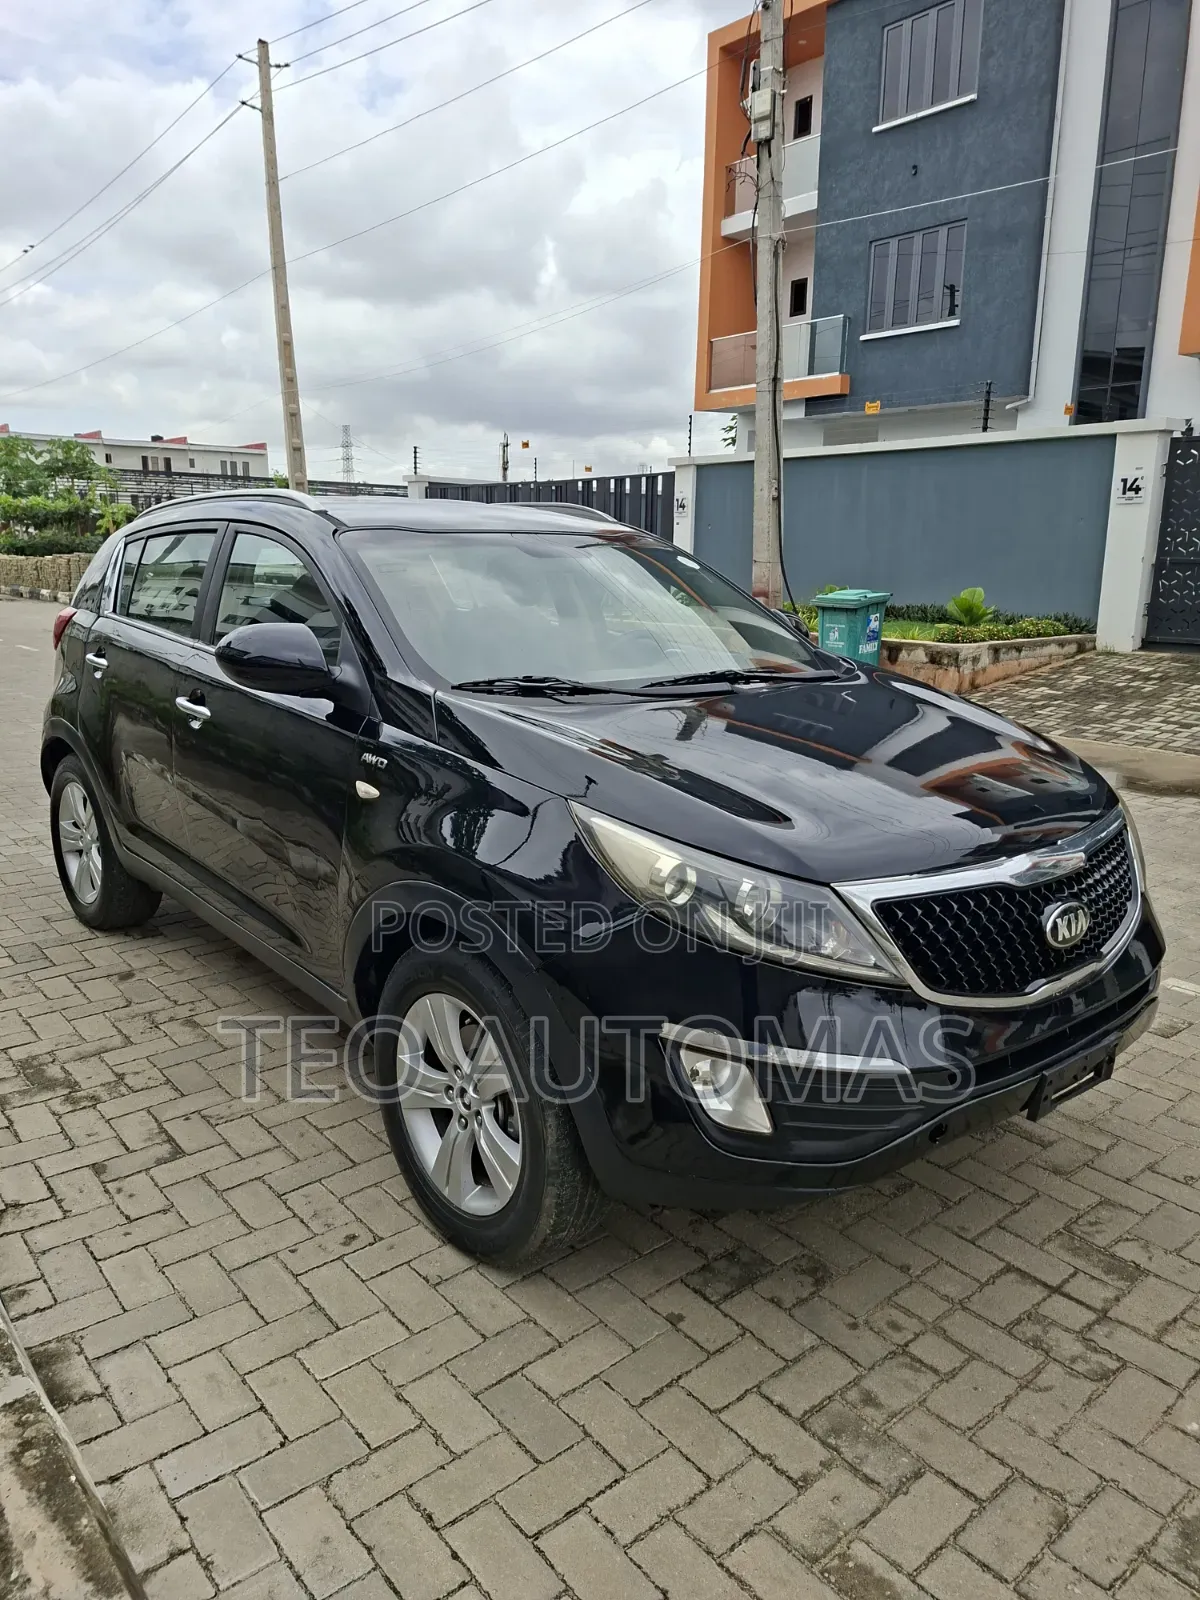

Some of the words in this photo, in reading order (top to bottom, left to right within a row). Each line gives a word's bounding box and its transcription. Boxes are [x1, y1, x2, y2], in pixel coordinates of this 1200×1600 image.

[1121, 477, 1142, 495] 14
[676, 498, 686, 511] 14
[859, 642, 878, 654] FAMILY
[360, 752, 388, 769] AWD
[1055, 909, 1087, 942] KIA
